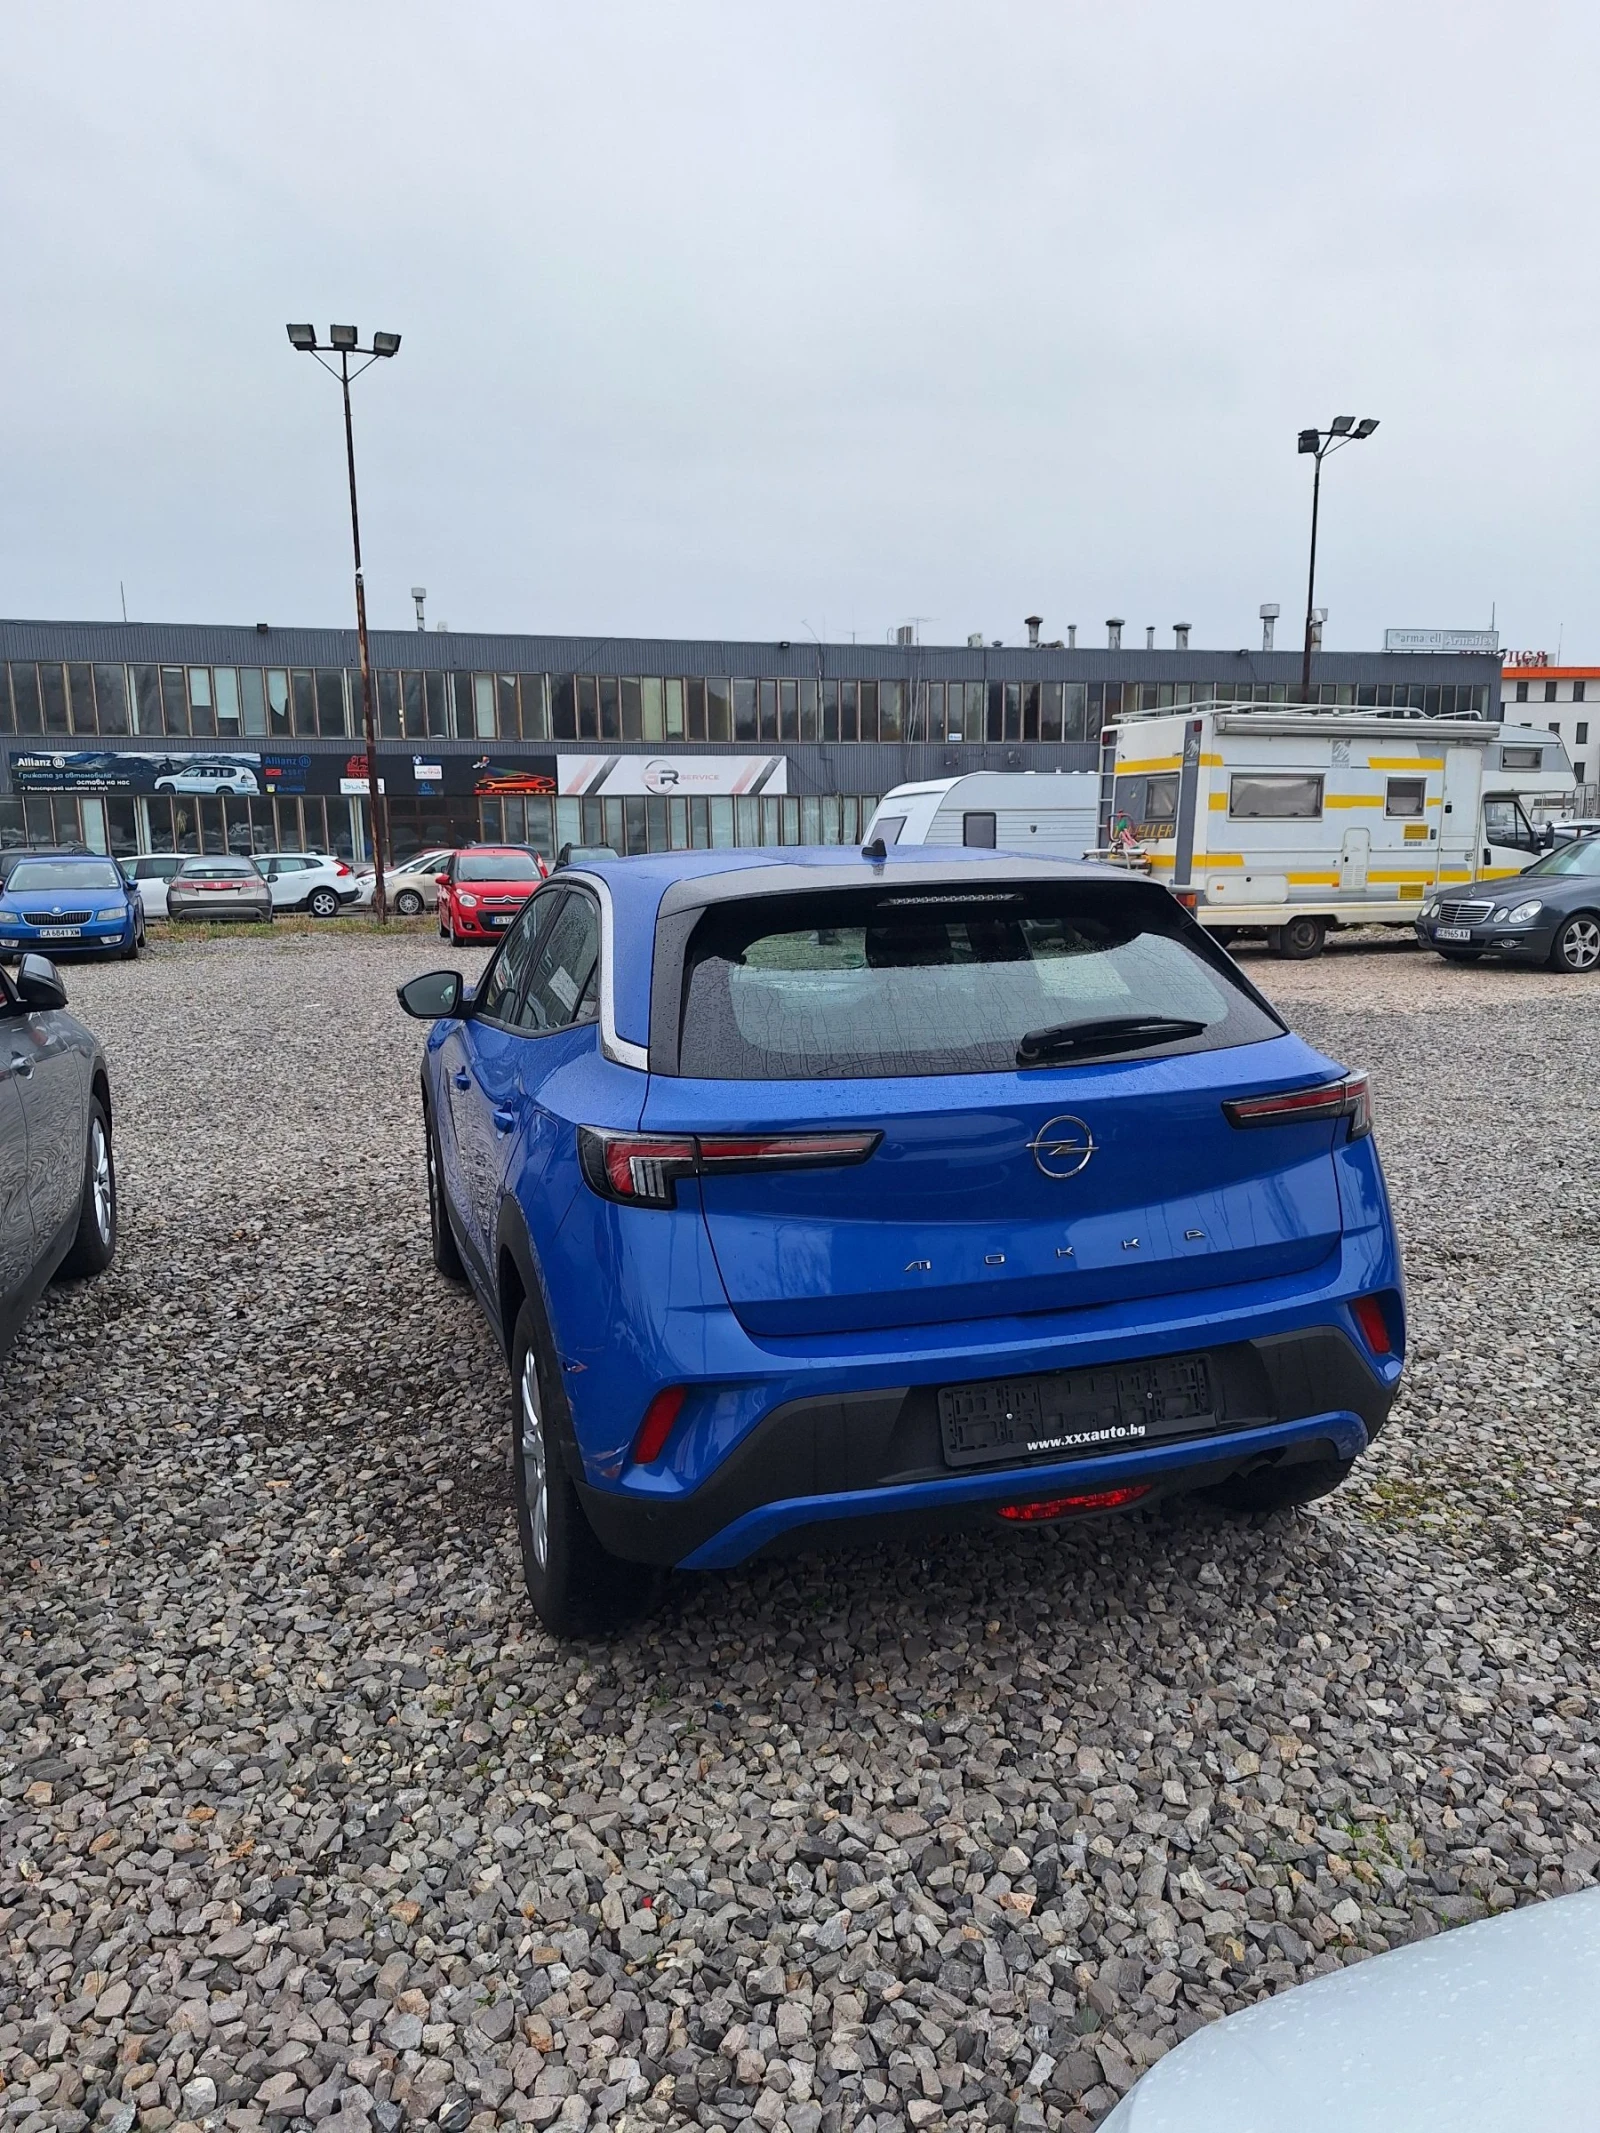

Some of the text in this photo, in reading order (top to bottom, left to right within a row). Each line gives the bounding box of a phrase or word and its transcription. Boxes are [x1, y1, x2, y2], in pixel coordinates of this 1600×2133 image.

[17, 758, 52, 767] Allianz
[264, 756, 297, 765] Allianz
[904, 1229, 1206, 1272] MOKKA
[1026, 1423, 1146, 1451] www.xxxauto.bg
